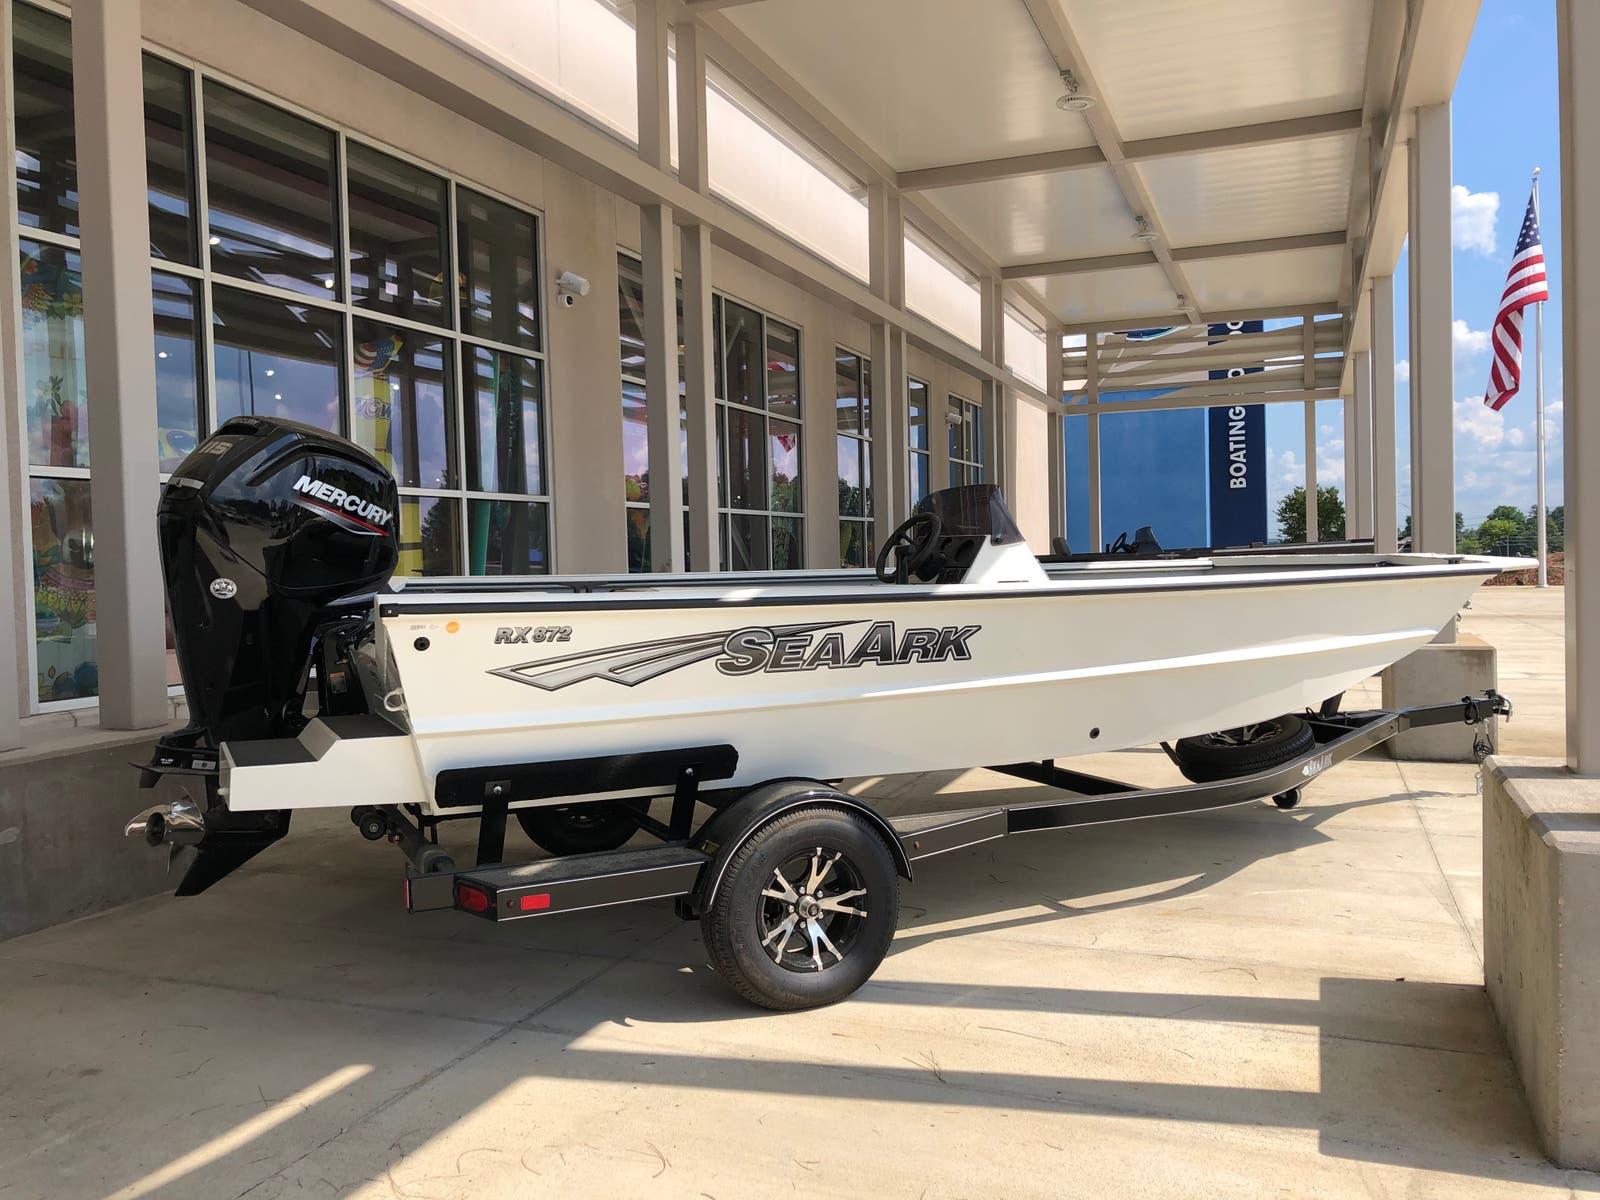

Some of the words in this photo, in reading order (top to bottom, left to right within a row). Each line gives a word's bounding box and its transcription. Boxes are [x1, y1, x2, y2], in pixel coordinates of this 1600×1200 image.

[1229, 405, 1247, 489] BOATING
[293, 475, 393, 526] MERCURY
[494, 626, 532, 644] RX
[532, 625, 573, 643] 872
